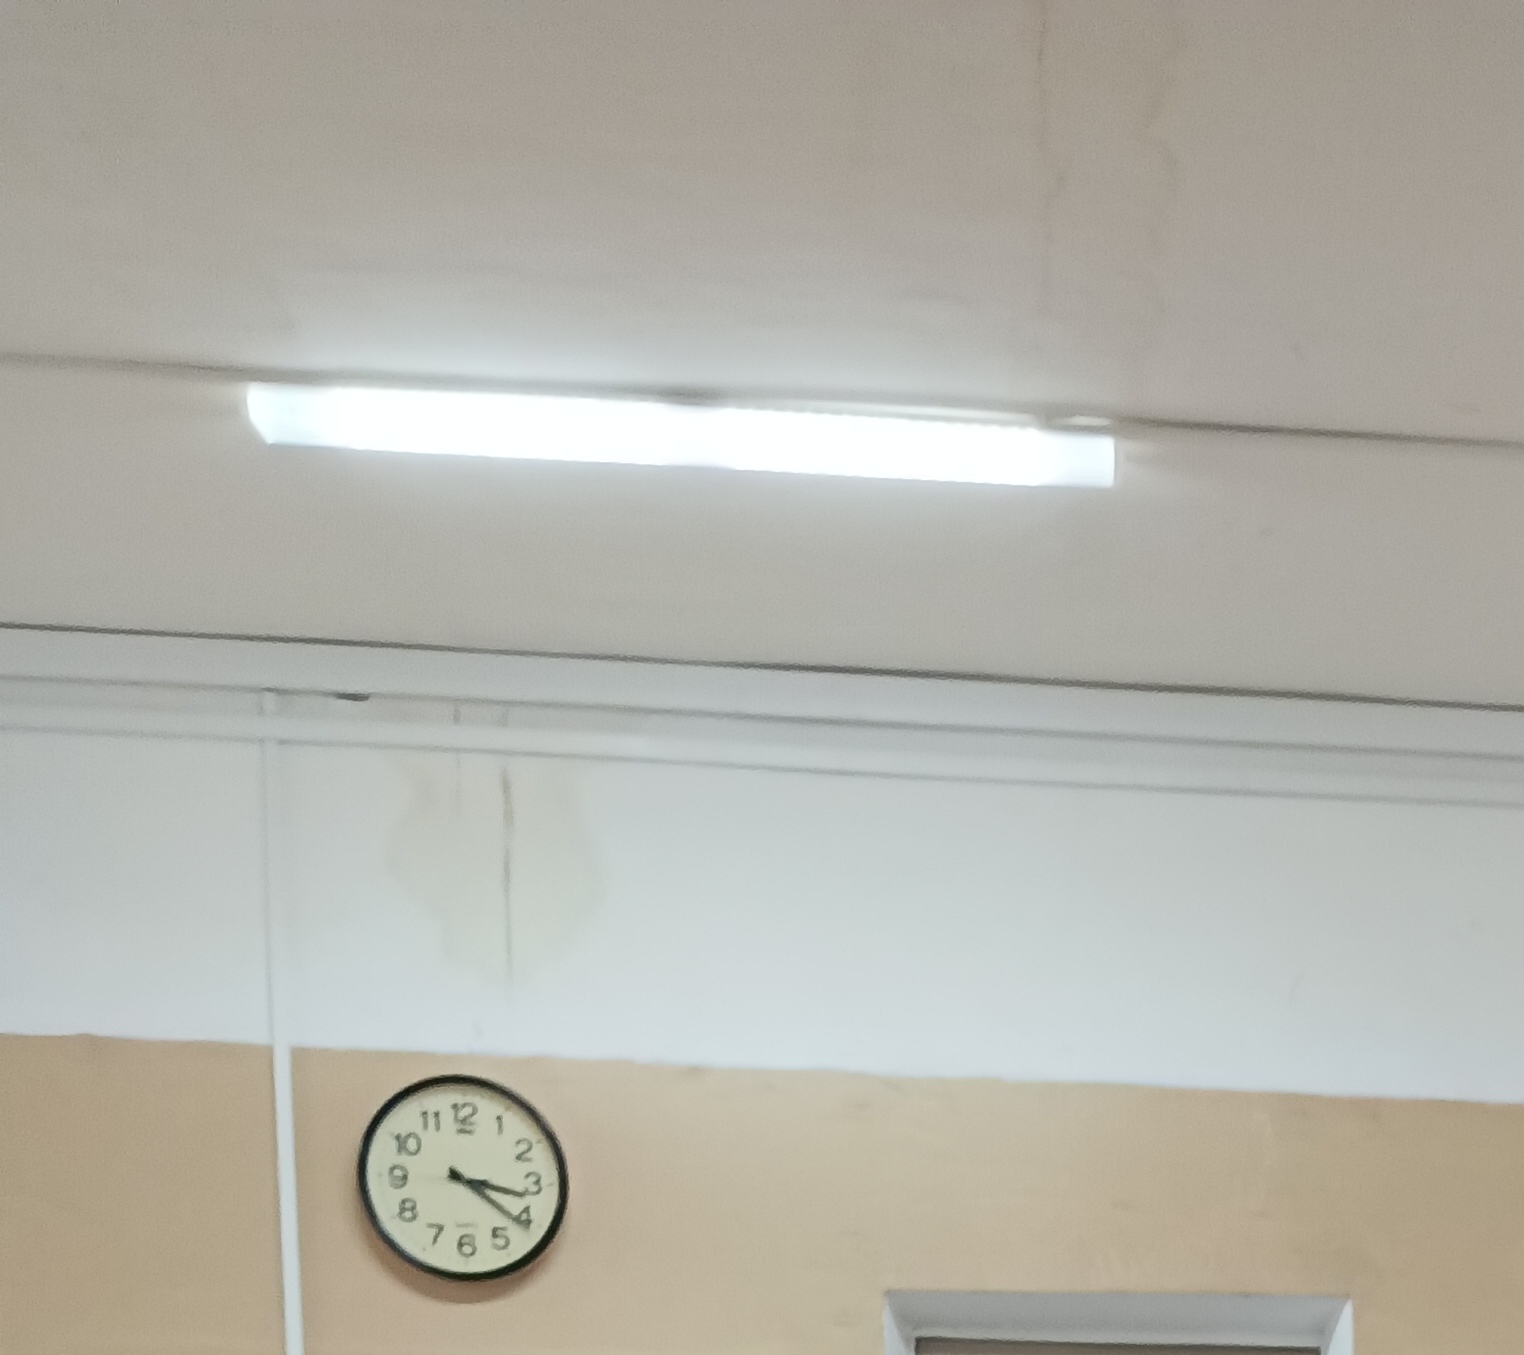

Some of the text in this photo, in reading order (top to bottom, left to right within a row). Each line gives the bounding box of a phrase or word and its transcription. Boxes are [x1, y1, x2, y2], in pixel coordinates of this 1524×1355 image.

[420, 1110, 441, 1132] 11
[451, 1102, 478, 1127] 12
[496, 1114, 504, 1135] 1
[394, 1132, 422, 1156] 10
[514, 1138, 533, 1162] 2
[388, 1164, 409, 1190] 9
[523, 1171, 543, 1195] 3
[398, 1198, 418, 1223] 8
[426, 1222, 445, 1246] 7
[457, 1233, 477, 1258] 6
[491, 1226, 510, 1251] 5
